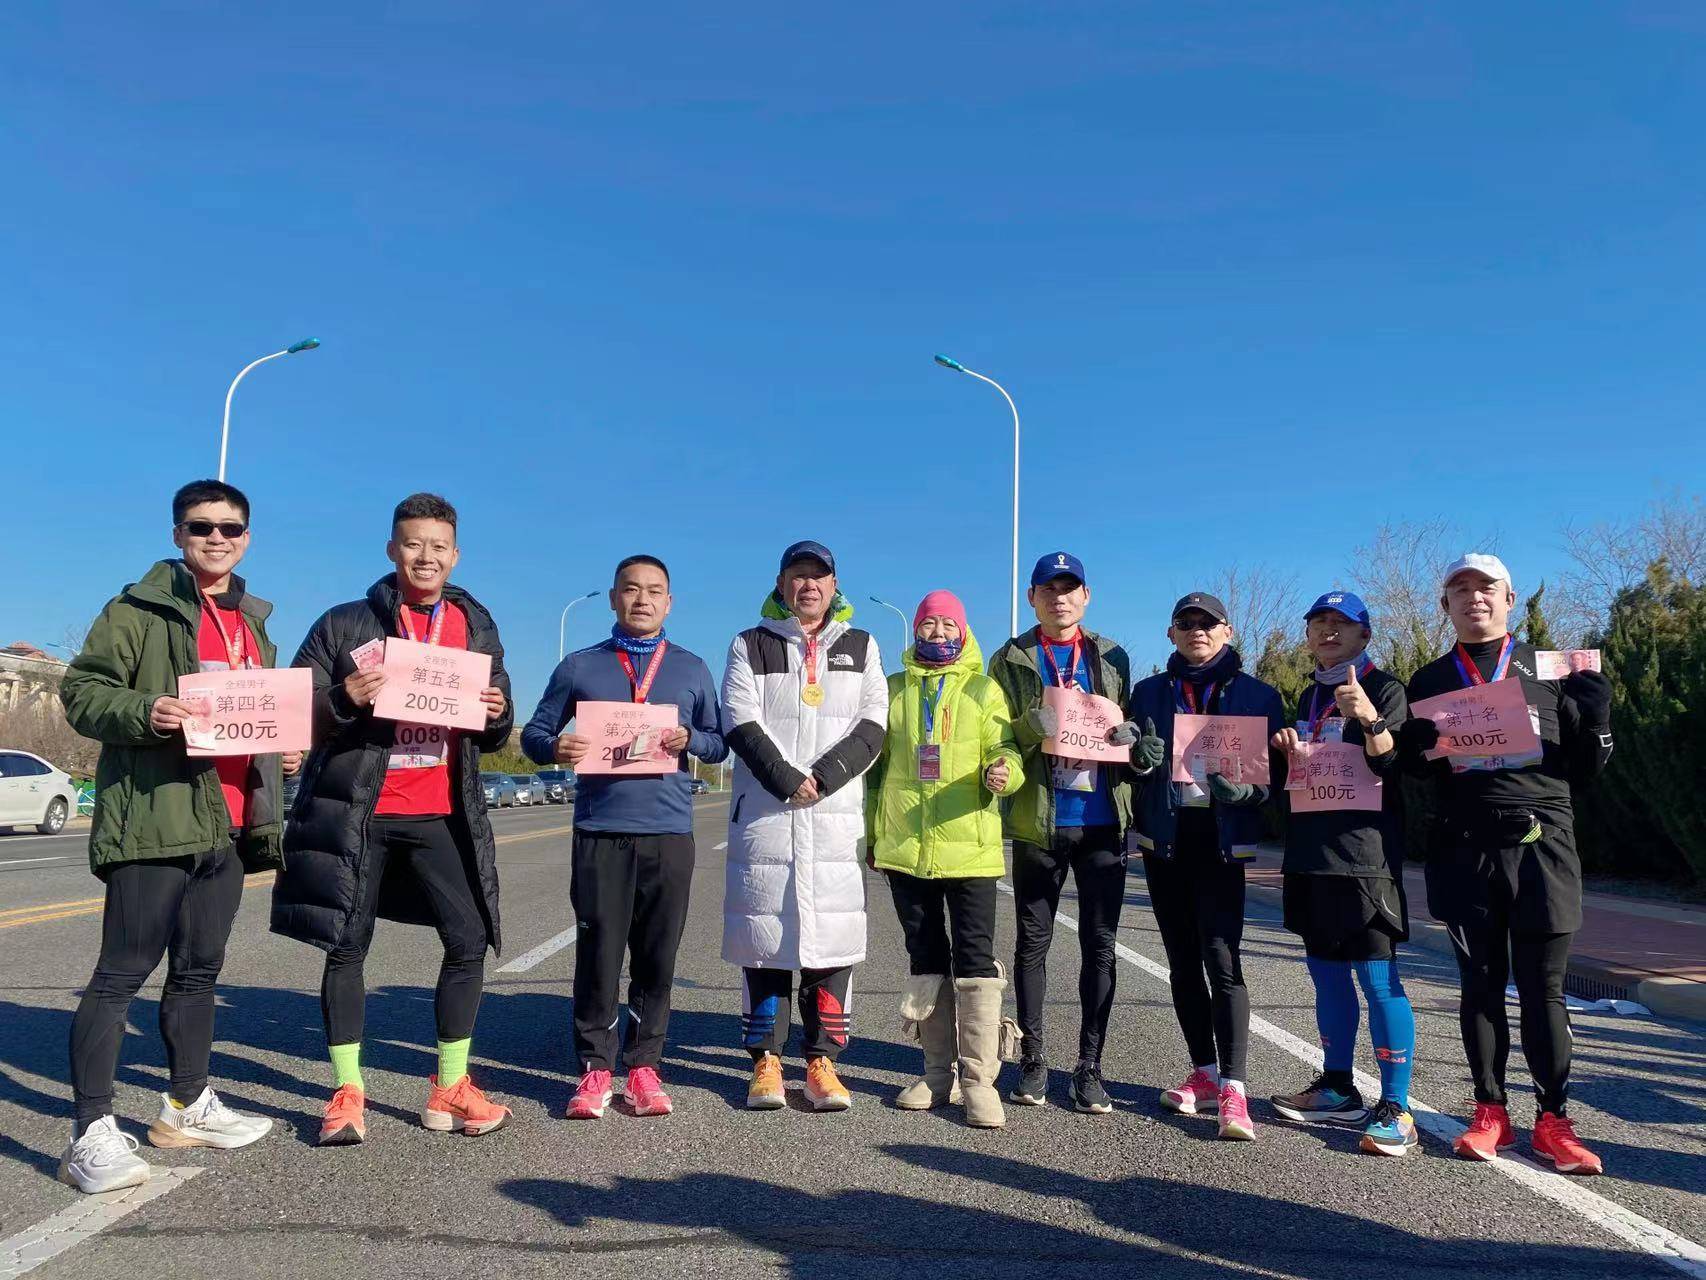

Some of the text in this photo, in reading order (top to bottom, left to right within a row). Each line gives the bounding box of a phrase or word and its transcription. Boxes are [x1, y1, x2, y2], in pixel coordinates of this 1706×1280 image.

[411, 667, 461, 690] 第五名
[216, 693, 276, 713] 第四名
[404, 693, 459, 716] 200元
[1065, 708, 1106, 729] 第七名
[1447, 706, 1498, 728] 第十名
[213, 720, 278, 741] 200元
[1060, 730, 1105, 751] 200元
[1449, 729, 1508, 747] 100元
[1201, 735, 1242, 751] 第八名
[1309, 762, 1354, 777] 第九名
[1310, 784, 1356, 800] 100元
